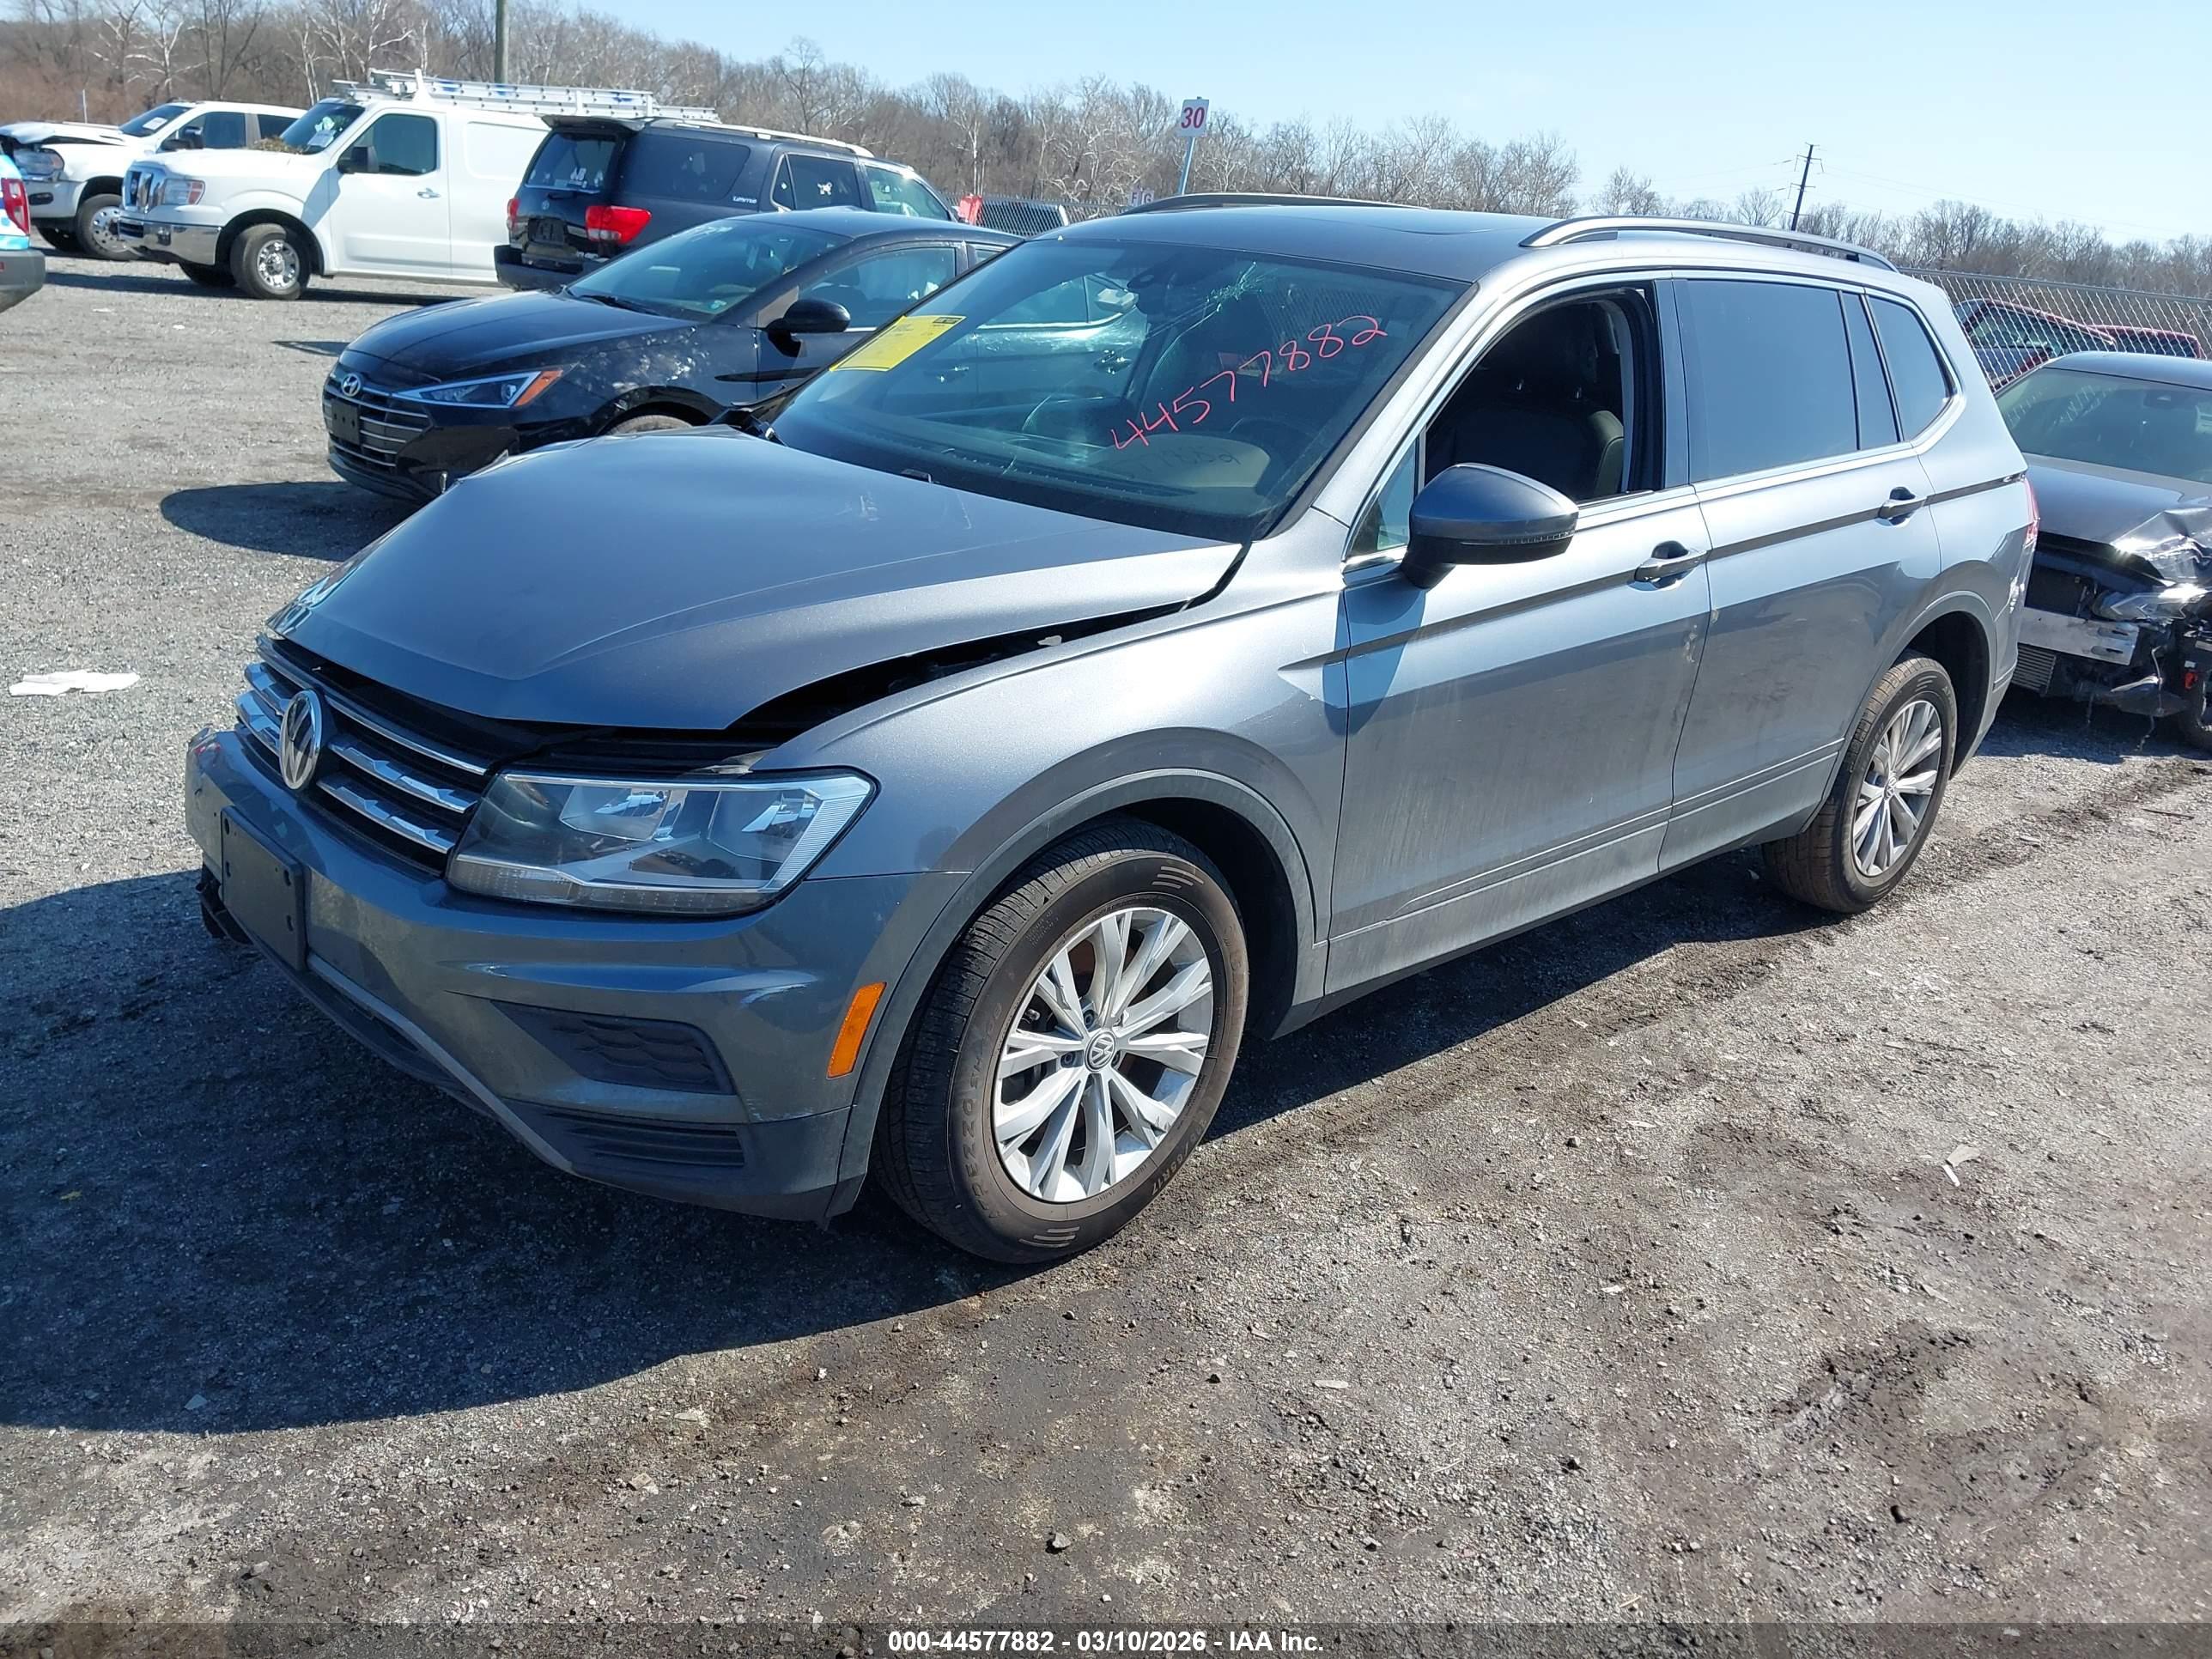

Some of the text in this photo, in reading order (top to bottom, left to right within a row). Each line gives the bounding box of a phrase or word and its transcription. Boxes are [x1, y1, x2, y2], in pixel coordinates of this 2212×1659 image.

[1181, 106, 1206, 129] 30
[1132, 191, 1138, 204] F
[1110, 315, 1388, 451] 44577882
